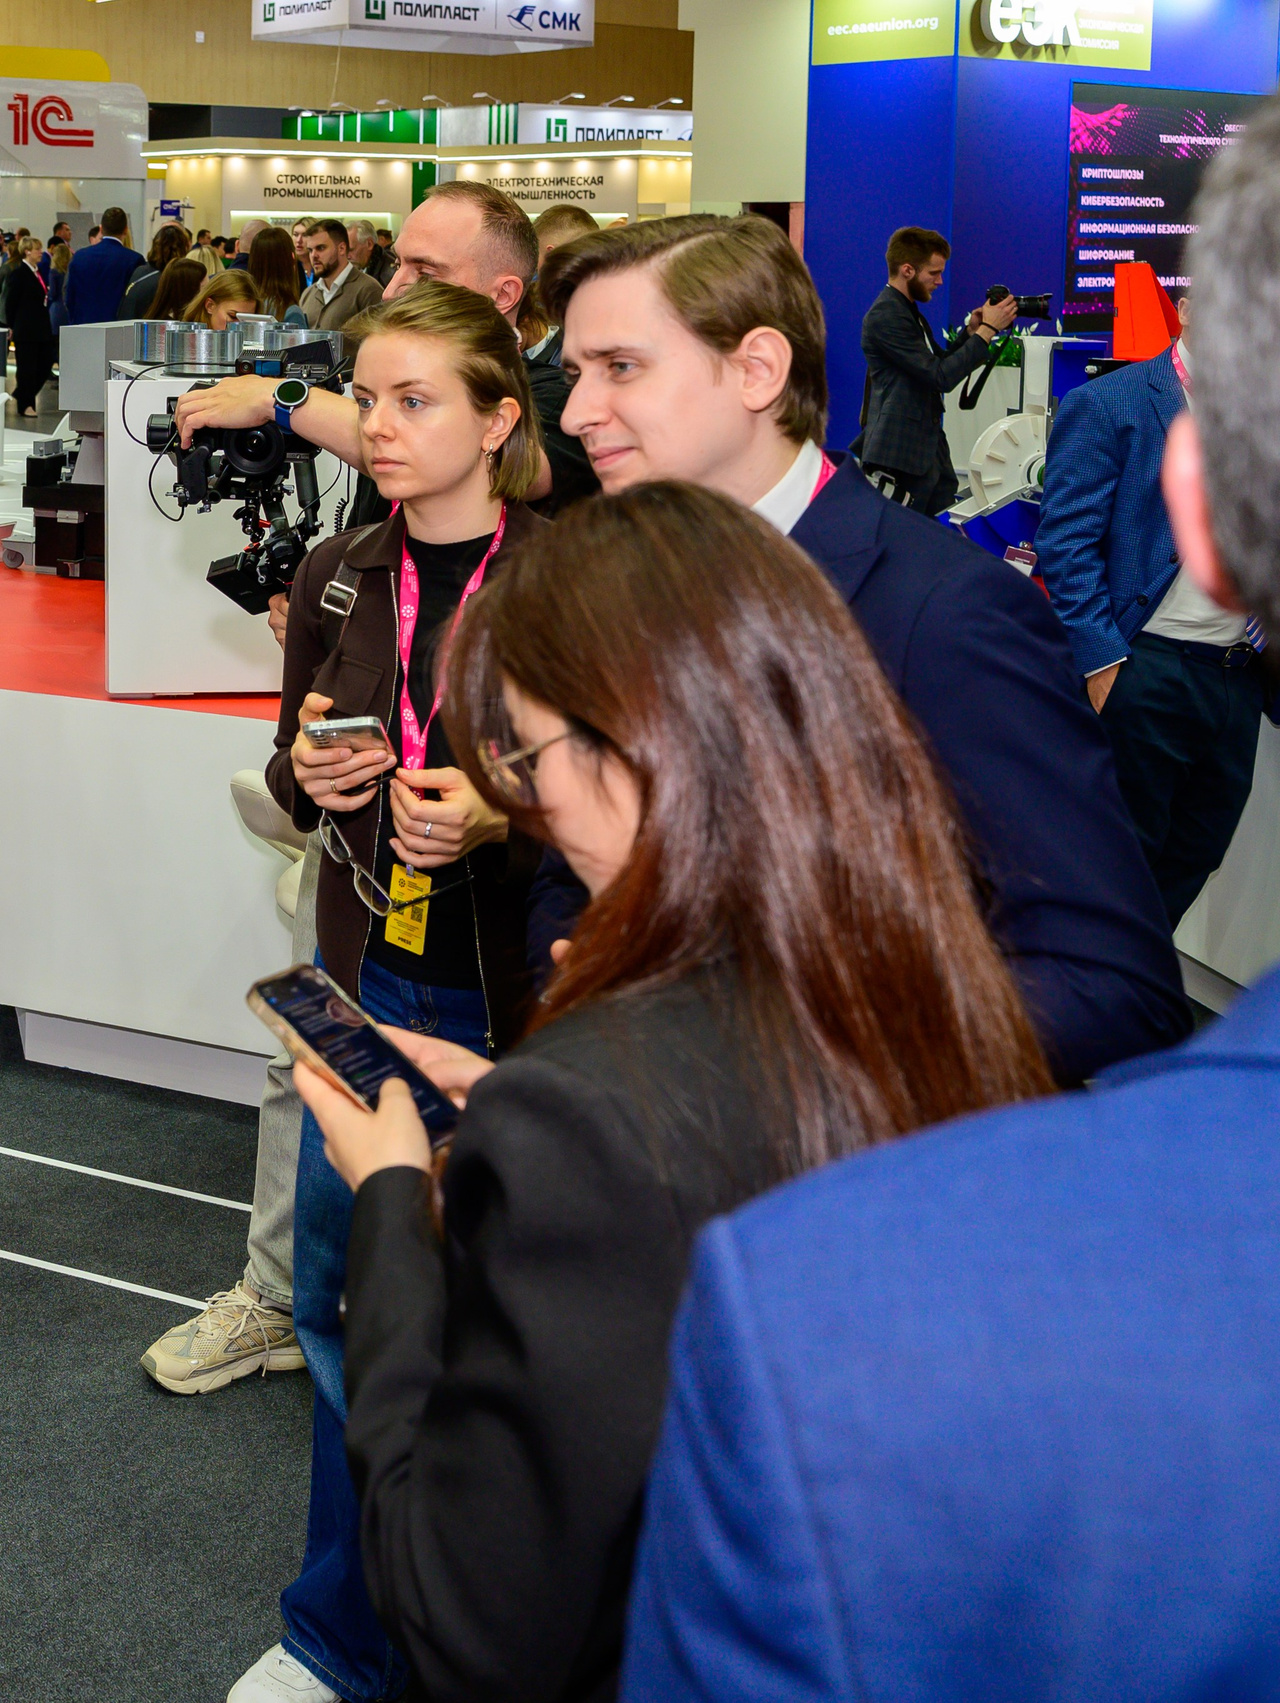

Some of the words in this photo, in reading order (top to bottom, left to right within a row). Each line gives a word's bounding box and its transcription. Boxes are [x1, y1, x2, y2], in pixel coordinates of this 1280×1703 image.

[538, 9, 581, 31] СМК
[827, 15, 939, 36] eec.eaeunion.org
[276, 174, 361, 186] СТРОИТЕЛЬНАЯ
[1081, 168, 1144, 180] КРИПТОШЛЮЗЫ
[486, 176, 604, 187] ЭЛЕКТРОТЕХНИЧЕСКАЯ
[263, 187, 373, 199] ПРОМЫШЛЕННОСТЬ
[507, 190, 596, 200] ОМЫШЛЕННОСТЬ
[1081, 195, 1165, 208] КИБЕРБЕЗОПАСНОСТЬ
[1079, 223, 1156, 236] ИНФОРМАЦИОННАЯ
[1157, 224, 1200, 235] БЕЗОПАСНО
[1078, 250, 1135, 261] ШИФРОВАНИЕ
[398, 937, 412, 945] PRESS
